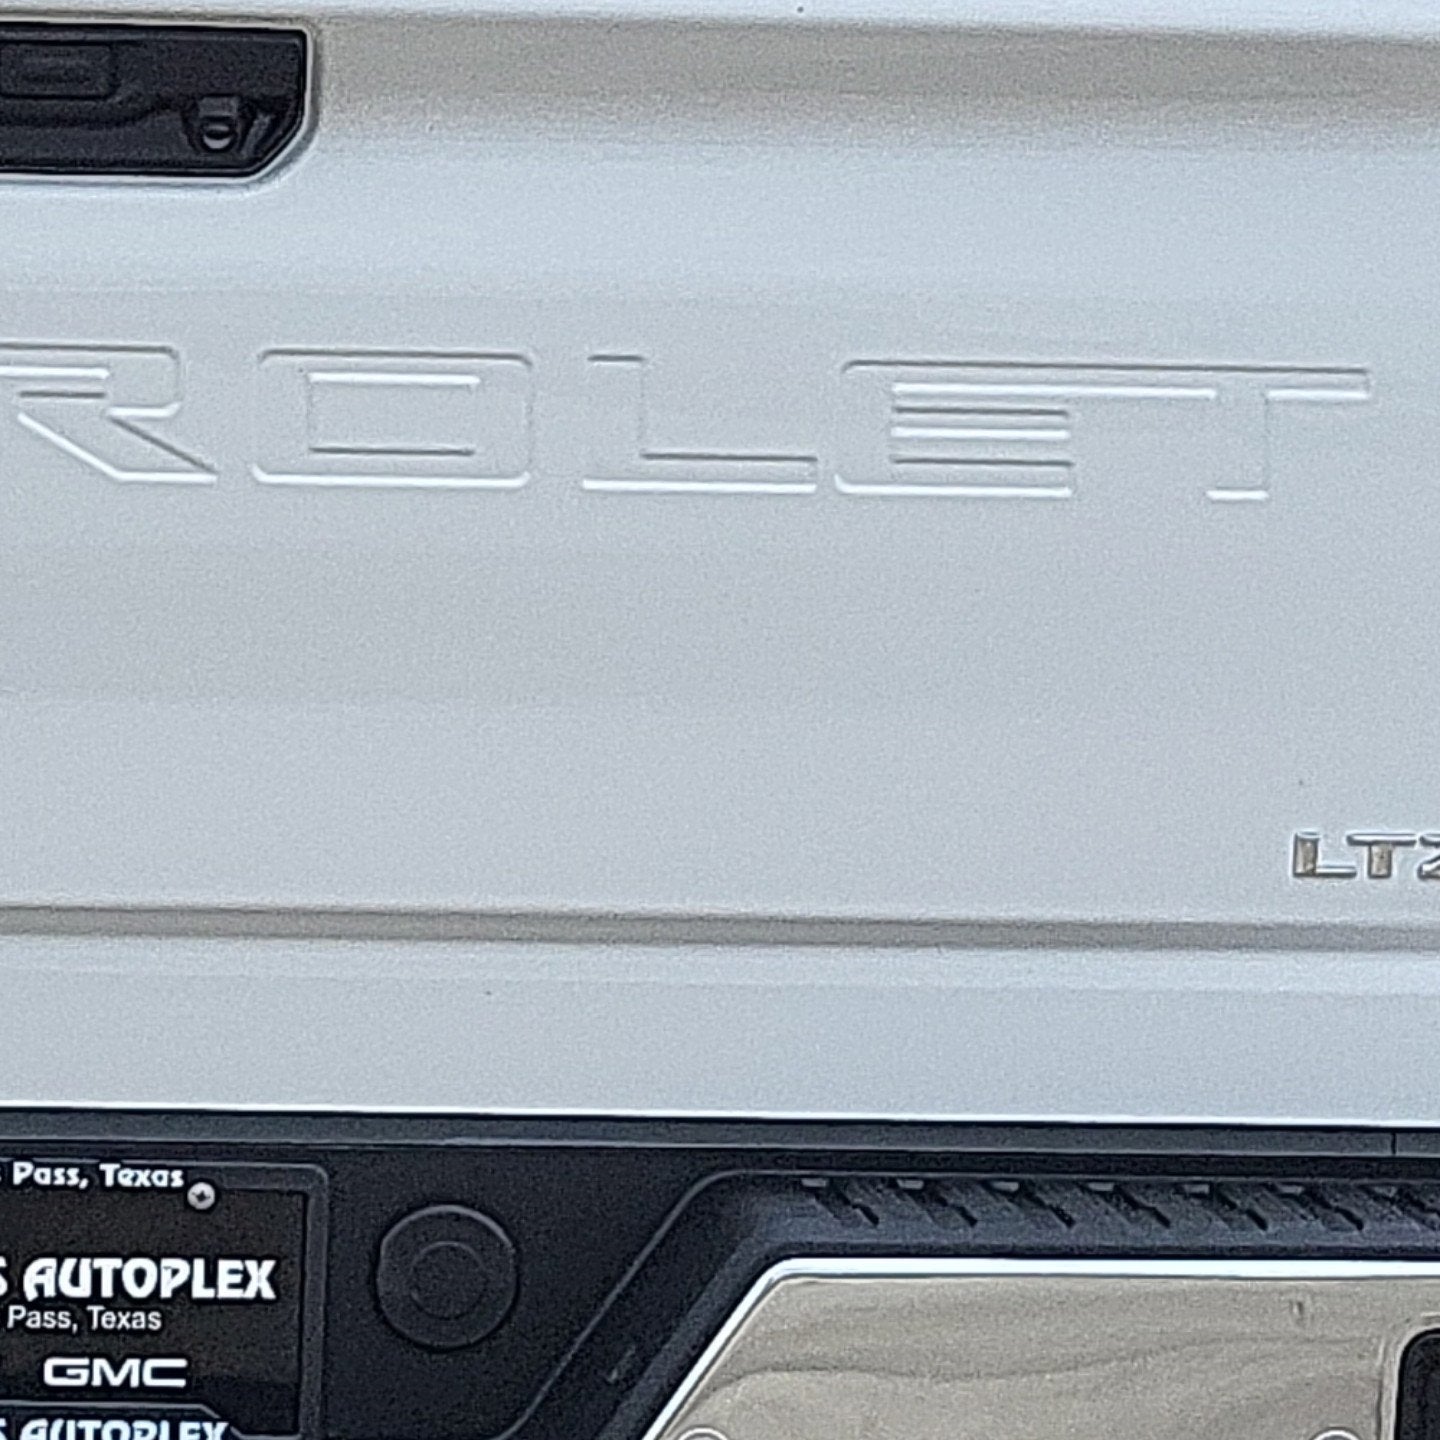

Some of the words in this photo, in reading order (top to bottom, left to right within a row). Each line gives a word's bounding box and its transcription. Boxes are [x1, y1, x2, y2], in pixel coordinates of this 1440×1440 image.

[12, 1161, 90, 1190] Pass,
[99, 1163, 184, 1188] Texas
[22, 1256, 277, 1301] AUTOPLEX
[7, 1305, 79, 1332] Pass,
[87, 1306, 163, 1330] Texas
[43, 1357, 187, 1388] GMC
